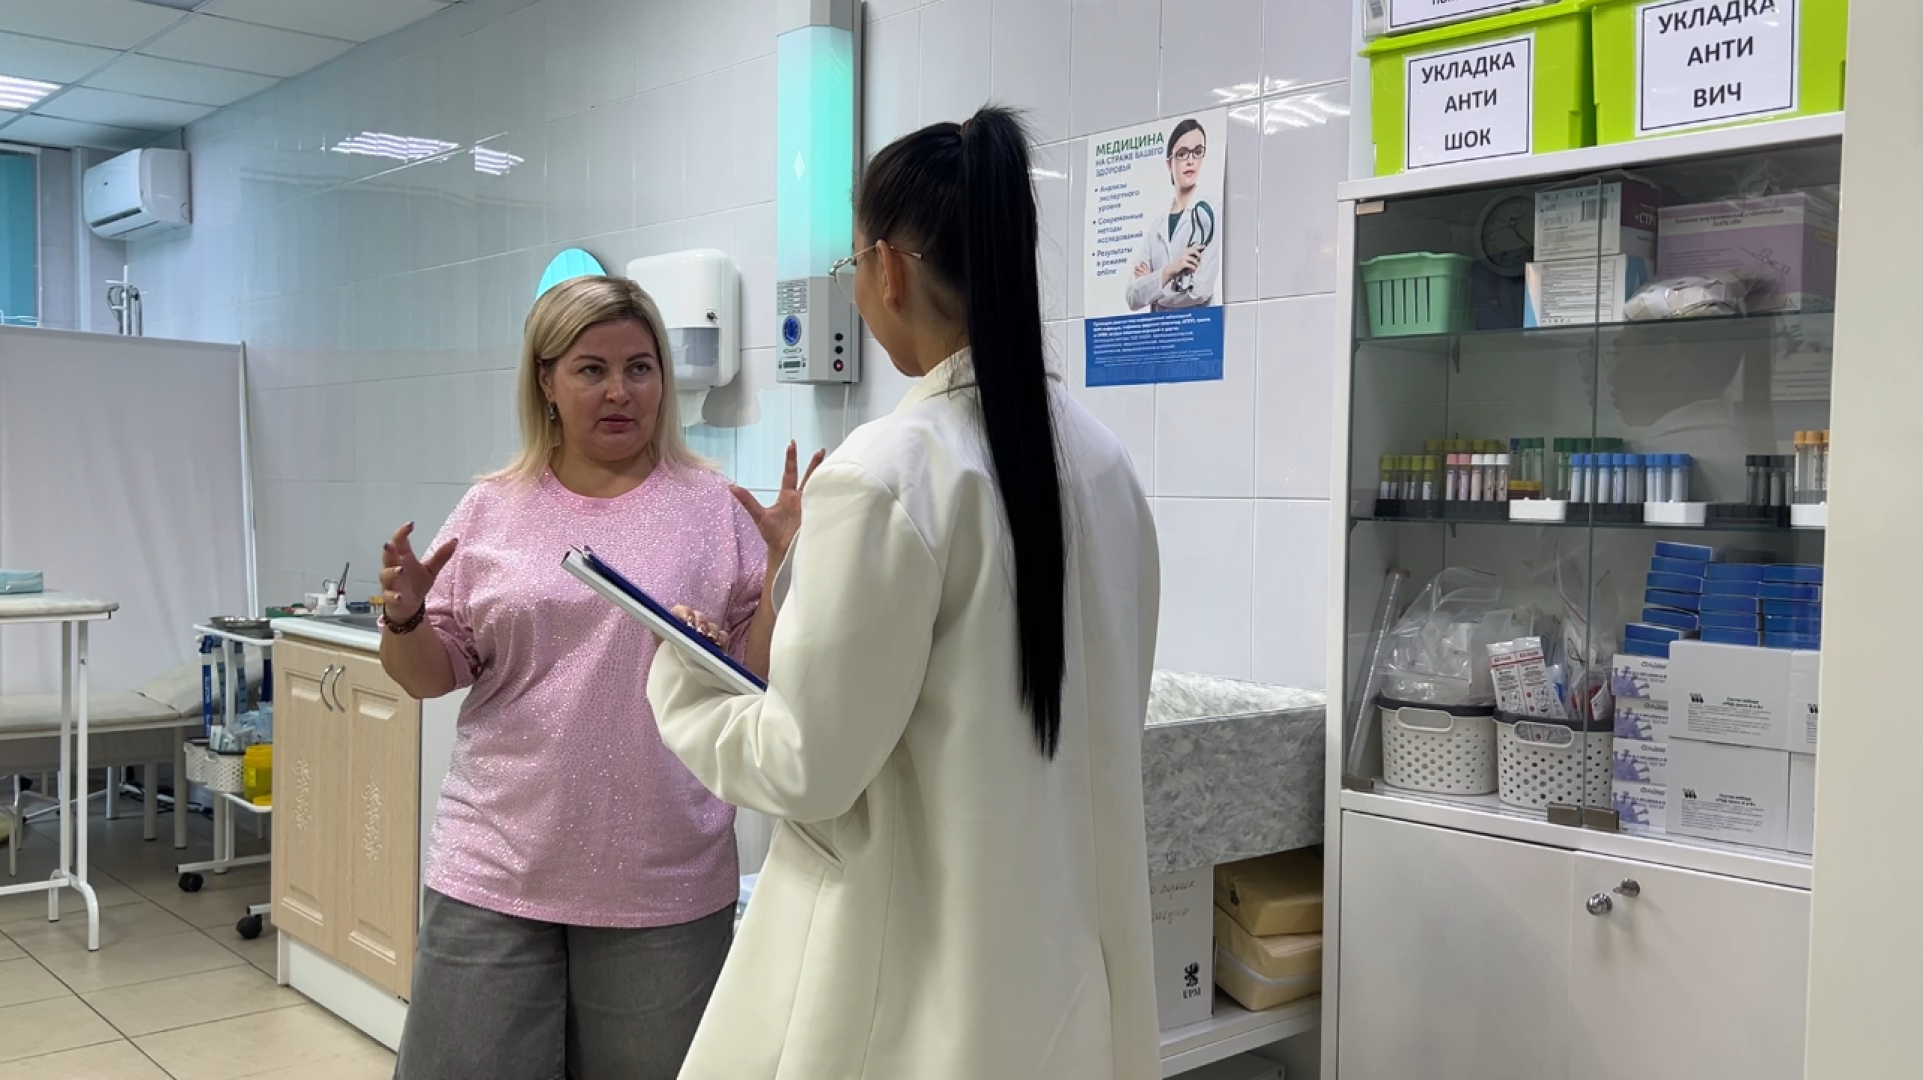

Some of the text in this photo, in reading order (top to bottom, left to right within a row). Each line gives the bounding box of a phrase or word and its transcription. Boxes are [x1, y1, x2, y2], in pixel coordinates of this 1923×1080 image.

[1656, 0, 1775, 35] УКЛАДКА
[1687, 35, 1754, 67] АНТИ
[1421, 51, 1516, 85] УКЛАДКА
[1444, 88, 1498, 114] АНТИ
[1692, 81, 1742, 109] ВИЧ
[1096, 132, 1165, 156] МЕДИЦИНА
[1444, 127, 1492, 151] ШОК
[1095, 147, 1164, 166] НА СТРАЖЕ ВАШЕГО
[1095, 163, 1131, 177] ЗДОРОВЬЯ
[1099, 182, 1127, 193] Анализы
[1099, 190, 1140, 203] экспертного
[1098, 203, 1121, 214] уровня
[1098, 212, 1143, 226] Современные
[1097, 226, 1122, 235] методы
[1097, 231, 1143, 244] исследований
[1097, 247, 1133, 258] Результаты
[1102, 257, 1128, 268] режиме
[1096, 268, 1117, 276] online
